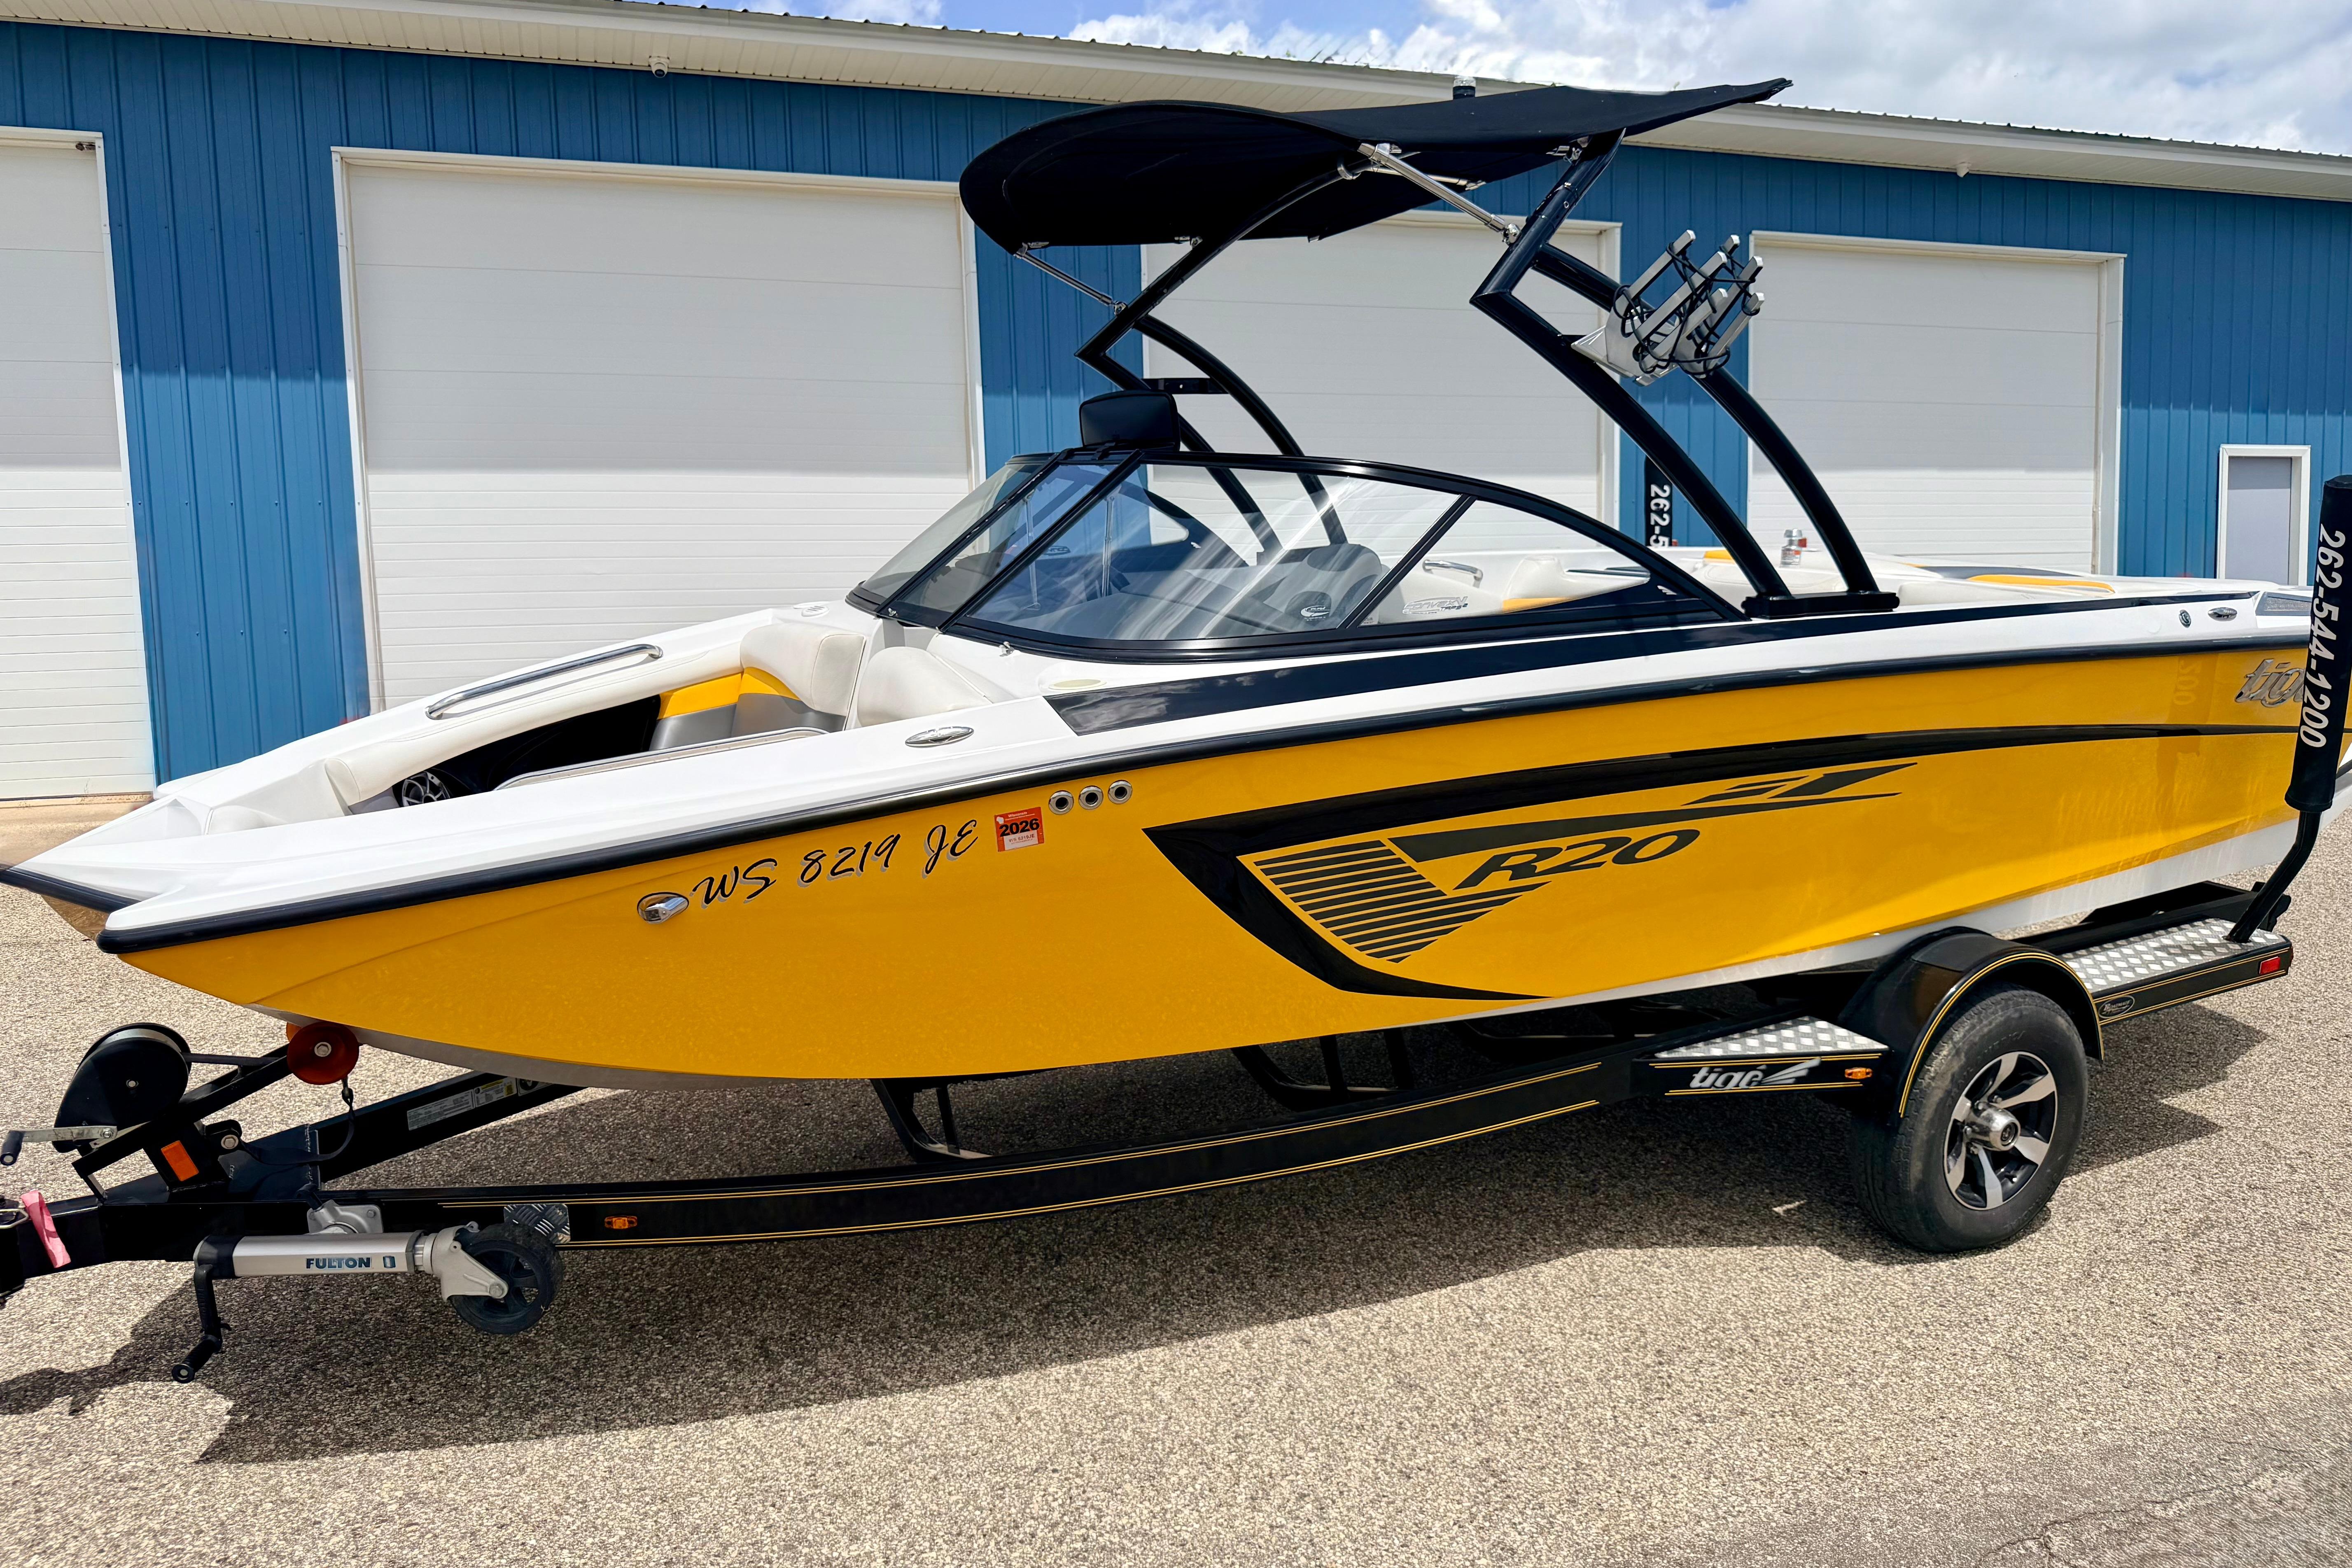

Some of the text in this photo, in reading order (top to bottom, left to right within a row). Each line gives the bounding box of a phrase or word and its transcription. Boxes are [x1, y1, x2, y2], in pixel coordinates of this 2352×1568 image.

[2301, 523, 2346, 748] 262-544-1200
[999, 818, 1040, 837] 2026
[691, 819, 978, 908] WS 8219 JE
[1452, 829, 1701, 890] R20
[306, 1257, 371, 1269] FULTON
